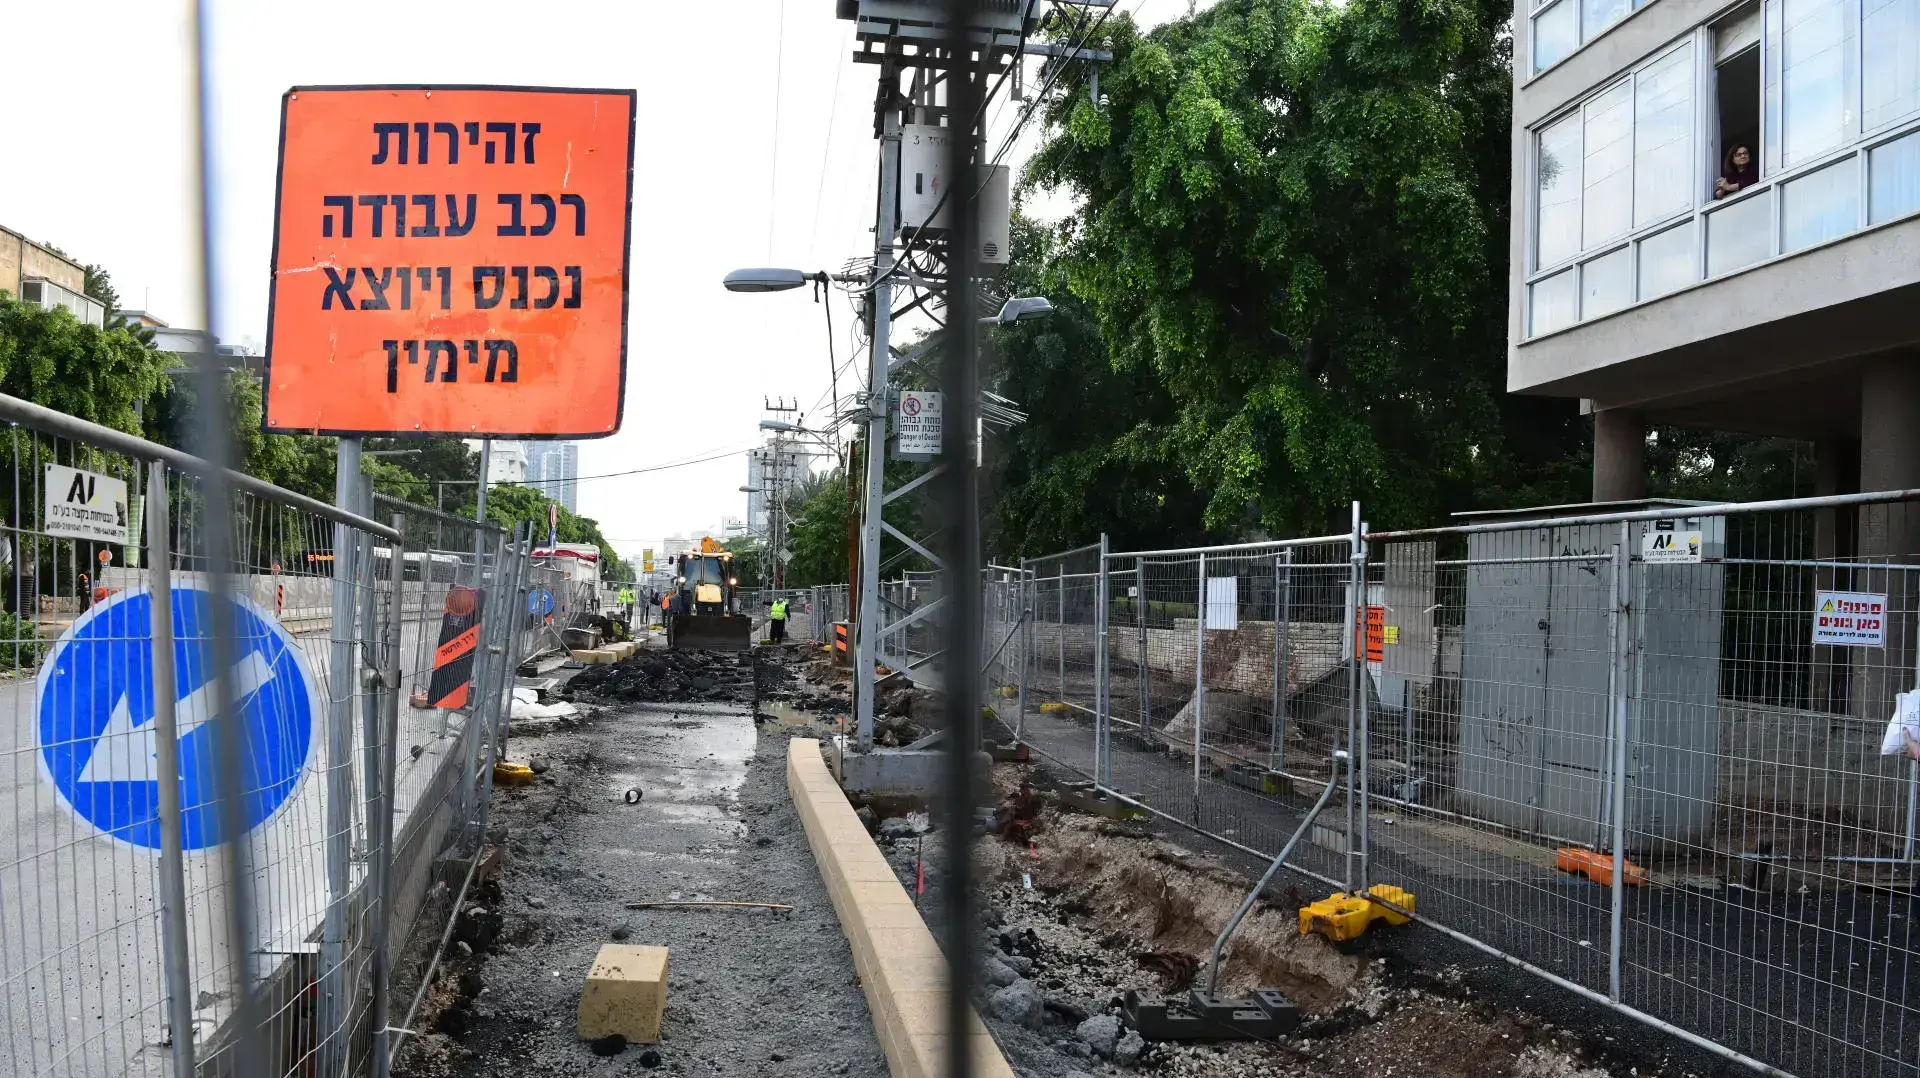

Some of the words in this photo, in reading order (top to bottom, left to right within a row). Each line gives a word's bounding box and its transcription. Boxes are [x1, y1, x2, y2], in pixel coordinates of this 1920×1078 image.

[371, 121, 541, 165] זהירות
[322, 193, 477, 238] עבודה
[496, 193, 587, 237] רכב
[321, 265, 451, 311] ויוצא
[472, 265, 582, 310] נכנס
[382, 339, 518, 393] מימין
[900, 433, 917, 441] Danger
[918, 433, 923, 441] of
[924, 416, 940, 424] מתח
[1819, 616, 1853, 628] בונים
[1837, 600, 1881, 614] סכנה!
[1856, 618, 1880, 630] כאן
